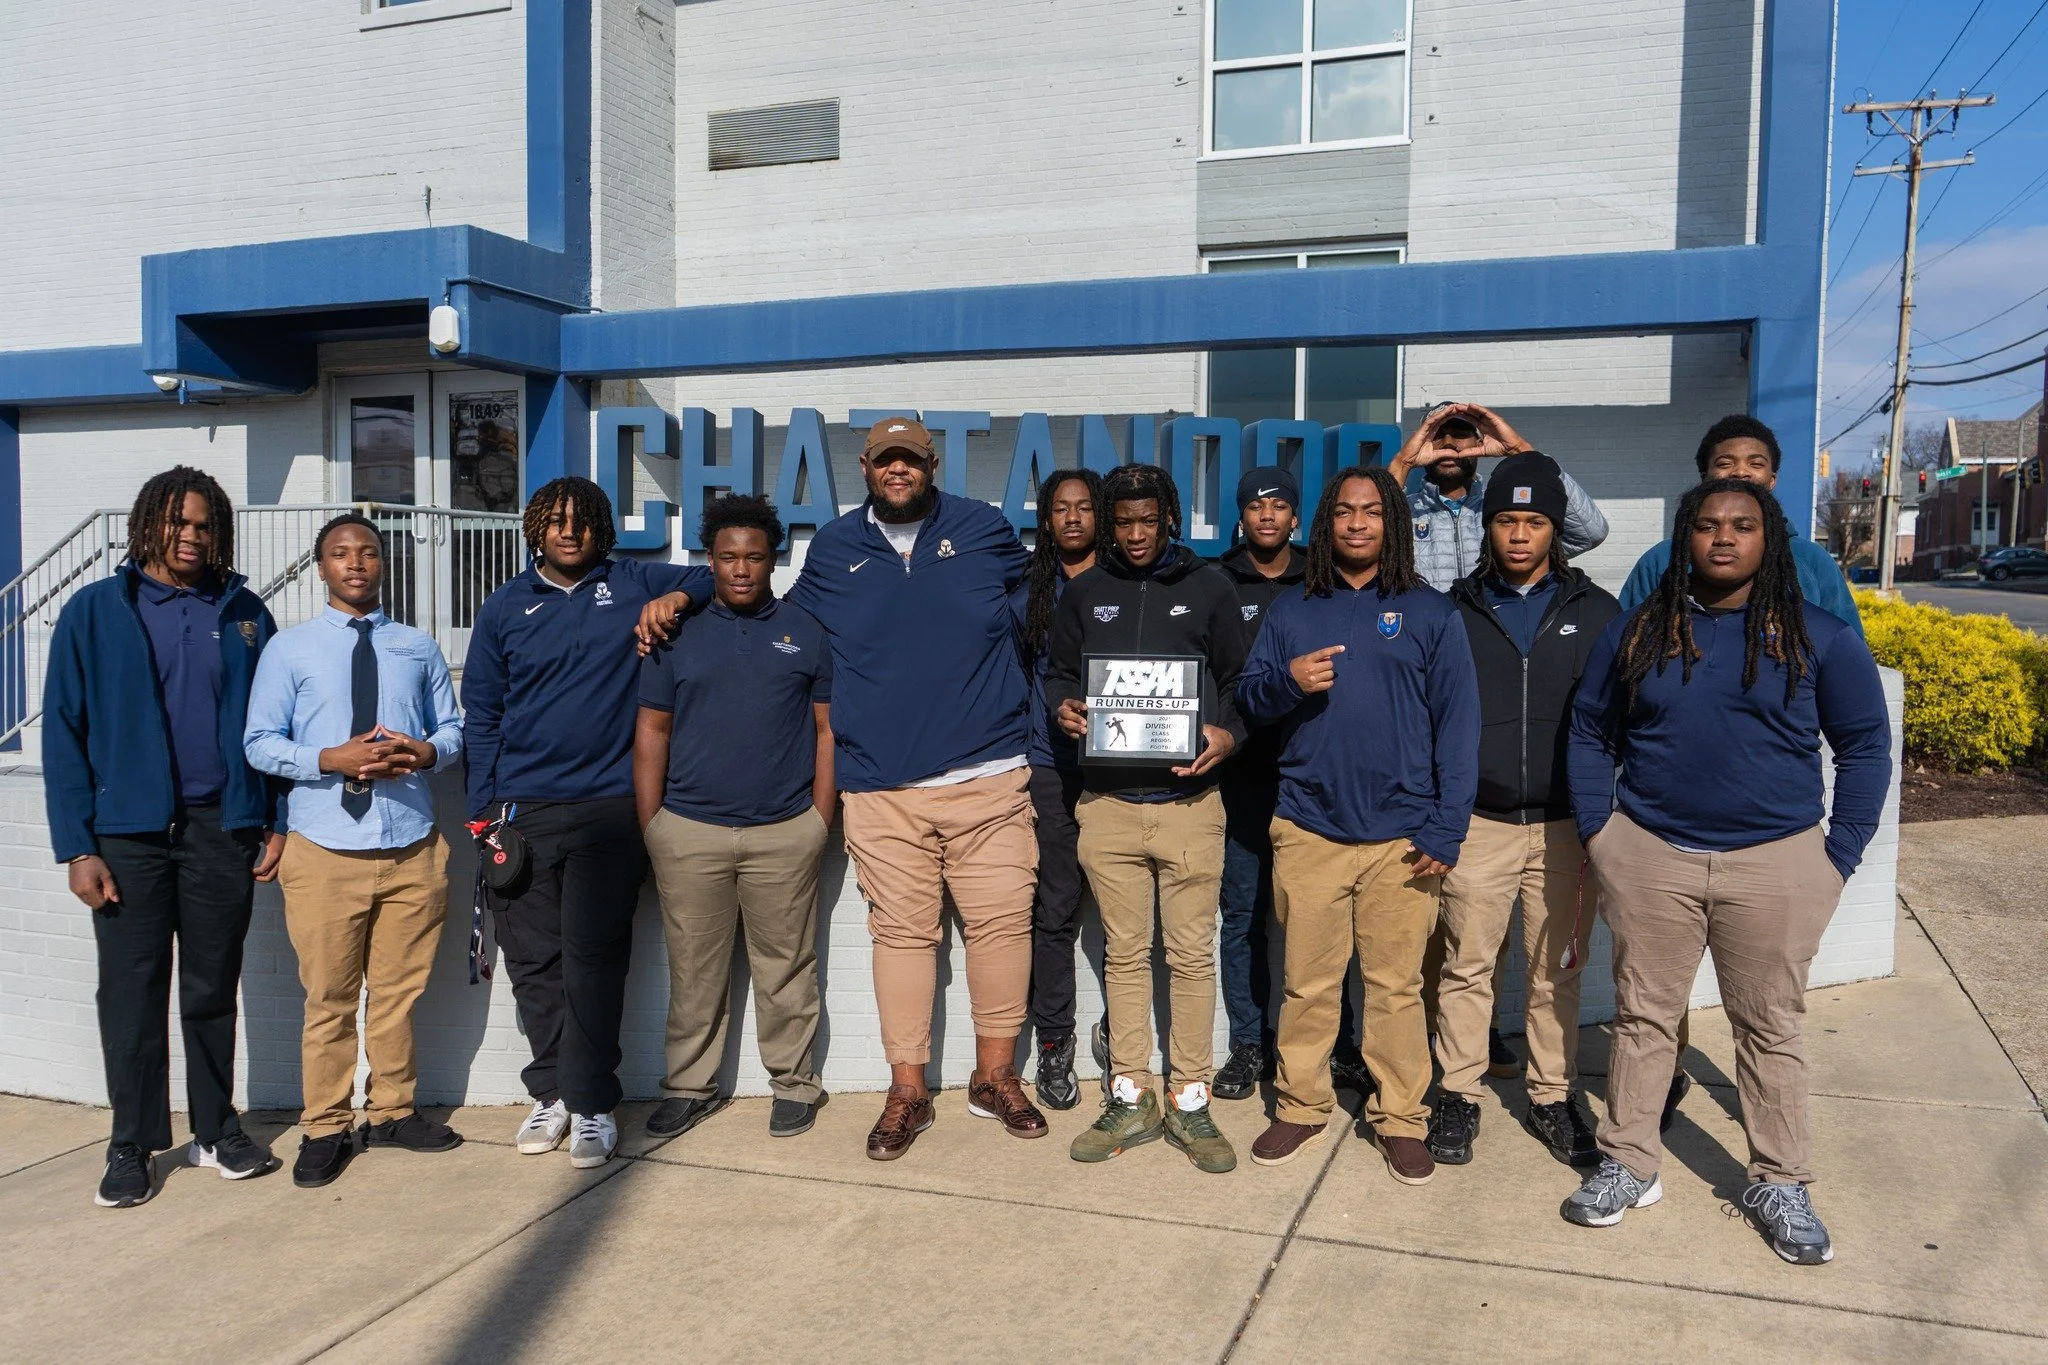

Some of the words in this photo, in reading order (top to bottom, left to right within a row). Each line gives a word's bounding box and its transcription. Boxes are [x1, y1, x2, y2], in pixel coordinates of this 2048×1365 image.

[470, 403, 500, 419] 1849
[597, 407, 1403, 560] CHATAOO
[1095, 698, 1190, 709] RUNNERS-UP
